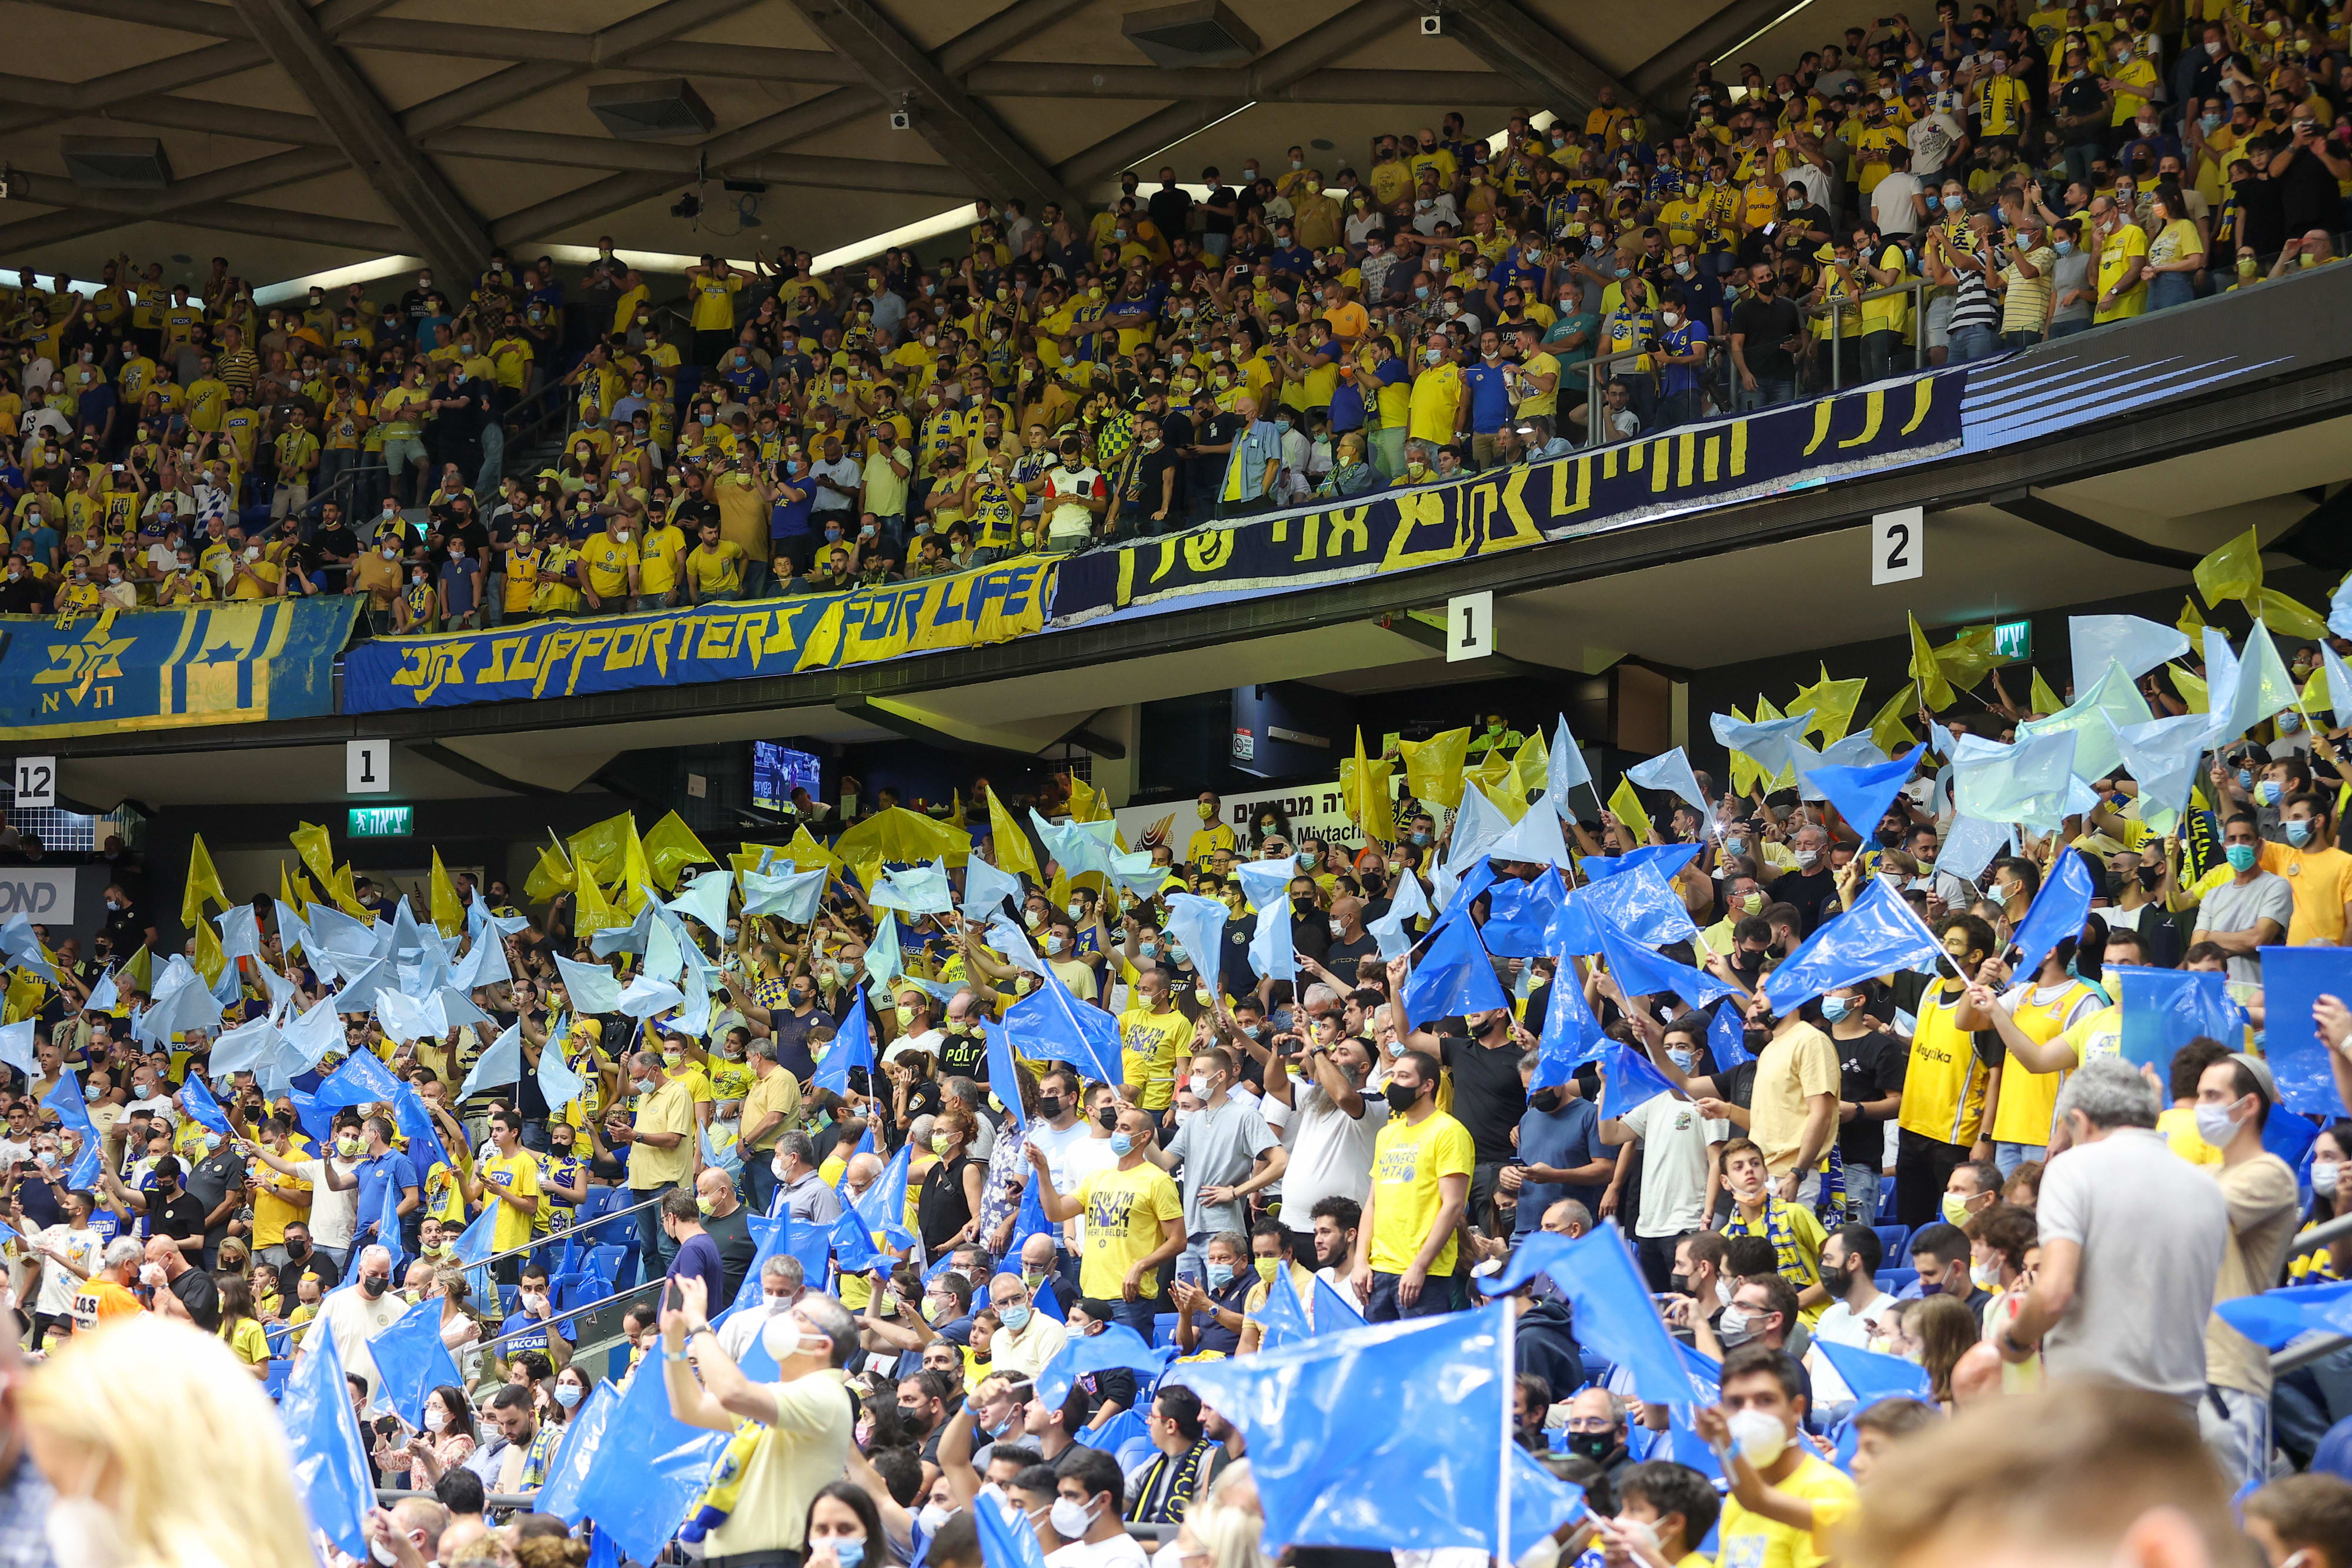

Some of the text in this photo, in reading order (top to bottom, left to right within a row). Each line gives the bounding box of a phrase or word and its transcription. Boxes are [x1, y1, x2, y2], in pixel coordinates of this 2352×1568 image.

[1726, 198, 1733, 207] 9
[1681, 336, 1687, 345] 9
[1887, 524, 1909, 569] 2
[520, 565, 525, 574] 1
[476, 563, 1043, 699] SUPPORTERS FOR LIFE
[1461, 607, 1477, 647] 1
[359, 750, 376, 783] 1
[18, 766, 51, 798] 12
[370, 810, 407, 834] יציאה
[1298, 825, 1361, 845] Mivtach
[1211, 841, 1217, 851] 7
[0, 882, 56, 913] OND
[1078, 941, 1090, 951] 14
[1130, 1024, 1165, 1039] NOW I'M
[1124, 1034, 1160, 1055] BACK
[723, 1071, 741, 1082] Dunk
[723, 1081, 733, 1090] the
[182, 1138, 205, 1147] MACCAB
[495, 1175, 511, 1183] OX
[1090, 1192, 1134, 1206] NOW I'M
[1088, 1206, 1130, 1228] BACK
[1105, 1229, 1127, 1238] BELONG
[1769, 1195, 1803, 1286] MPIRE
[507, 1338, 547, 1350] MACCABI
